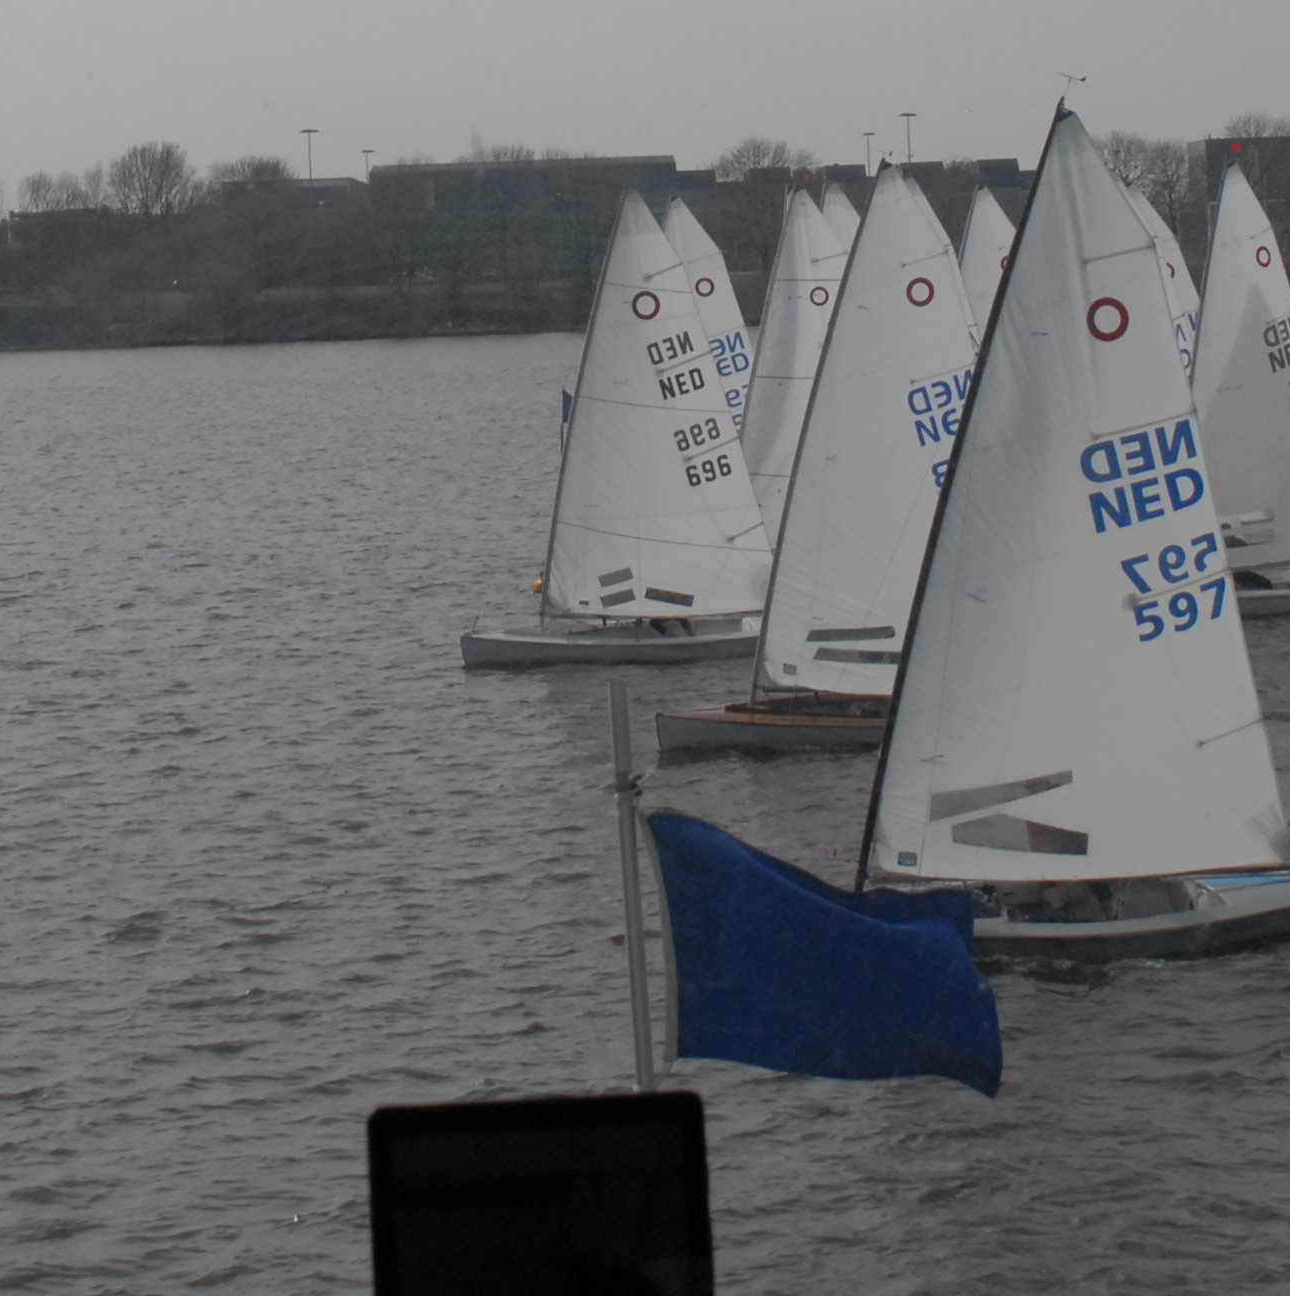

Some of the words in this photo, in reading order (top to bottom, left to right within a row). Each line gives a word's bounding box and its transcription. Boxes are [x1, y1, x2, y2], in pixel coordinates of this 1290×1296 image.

[716, 352, 749, 377] ED
[658, 367, 705, 400] NED
[914, 408, 961, 447] NE
[685, 454, 732, 487] 696
[1088, 467, 1204, 533] NED
[1133, 577, 1227, 642] 597
